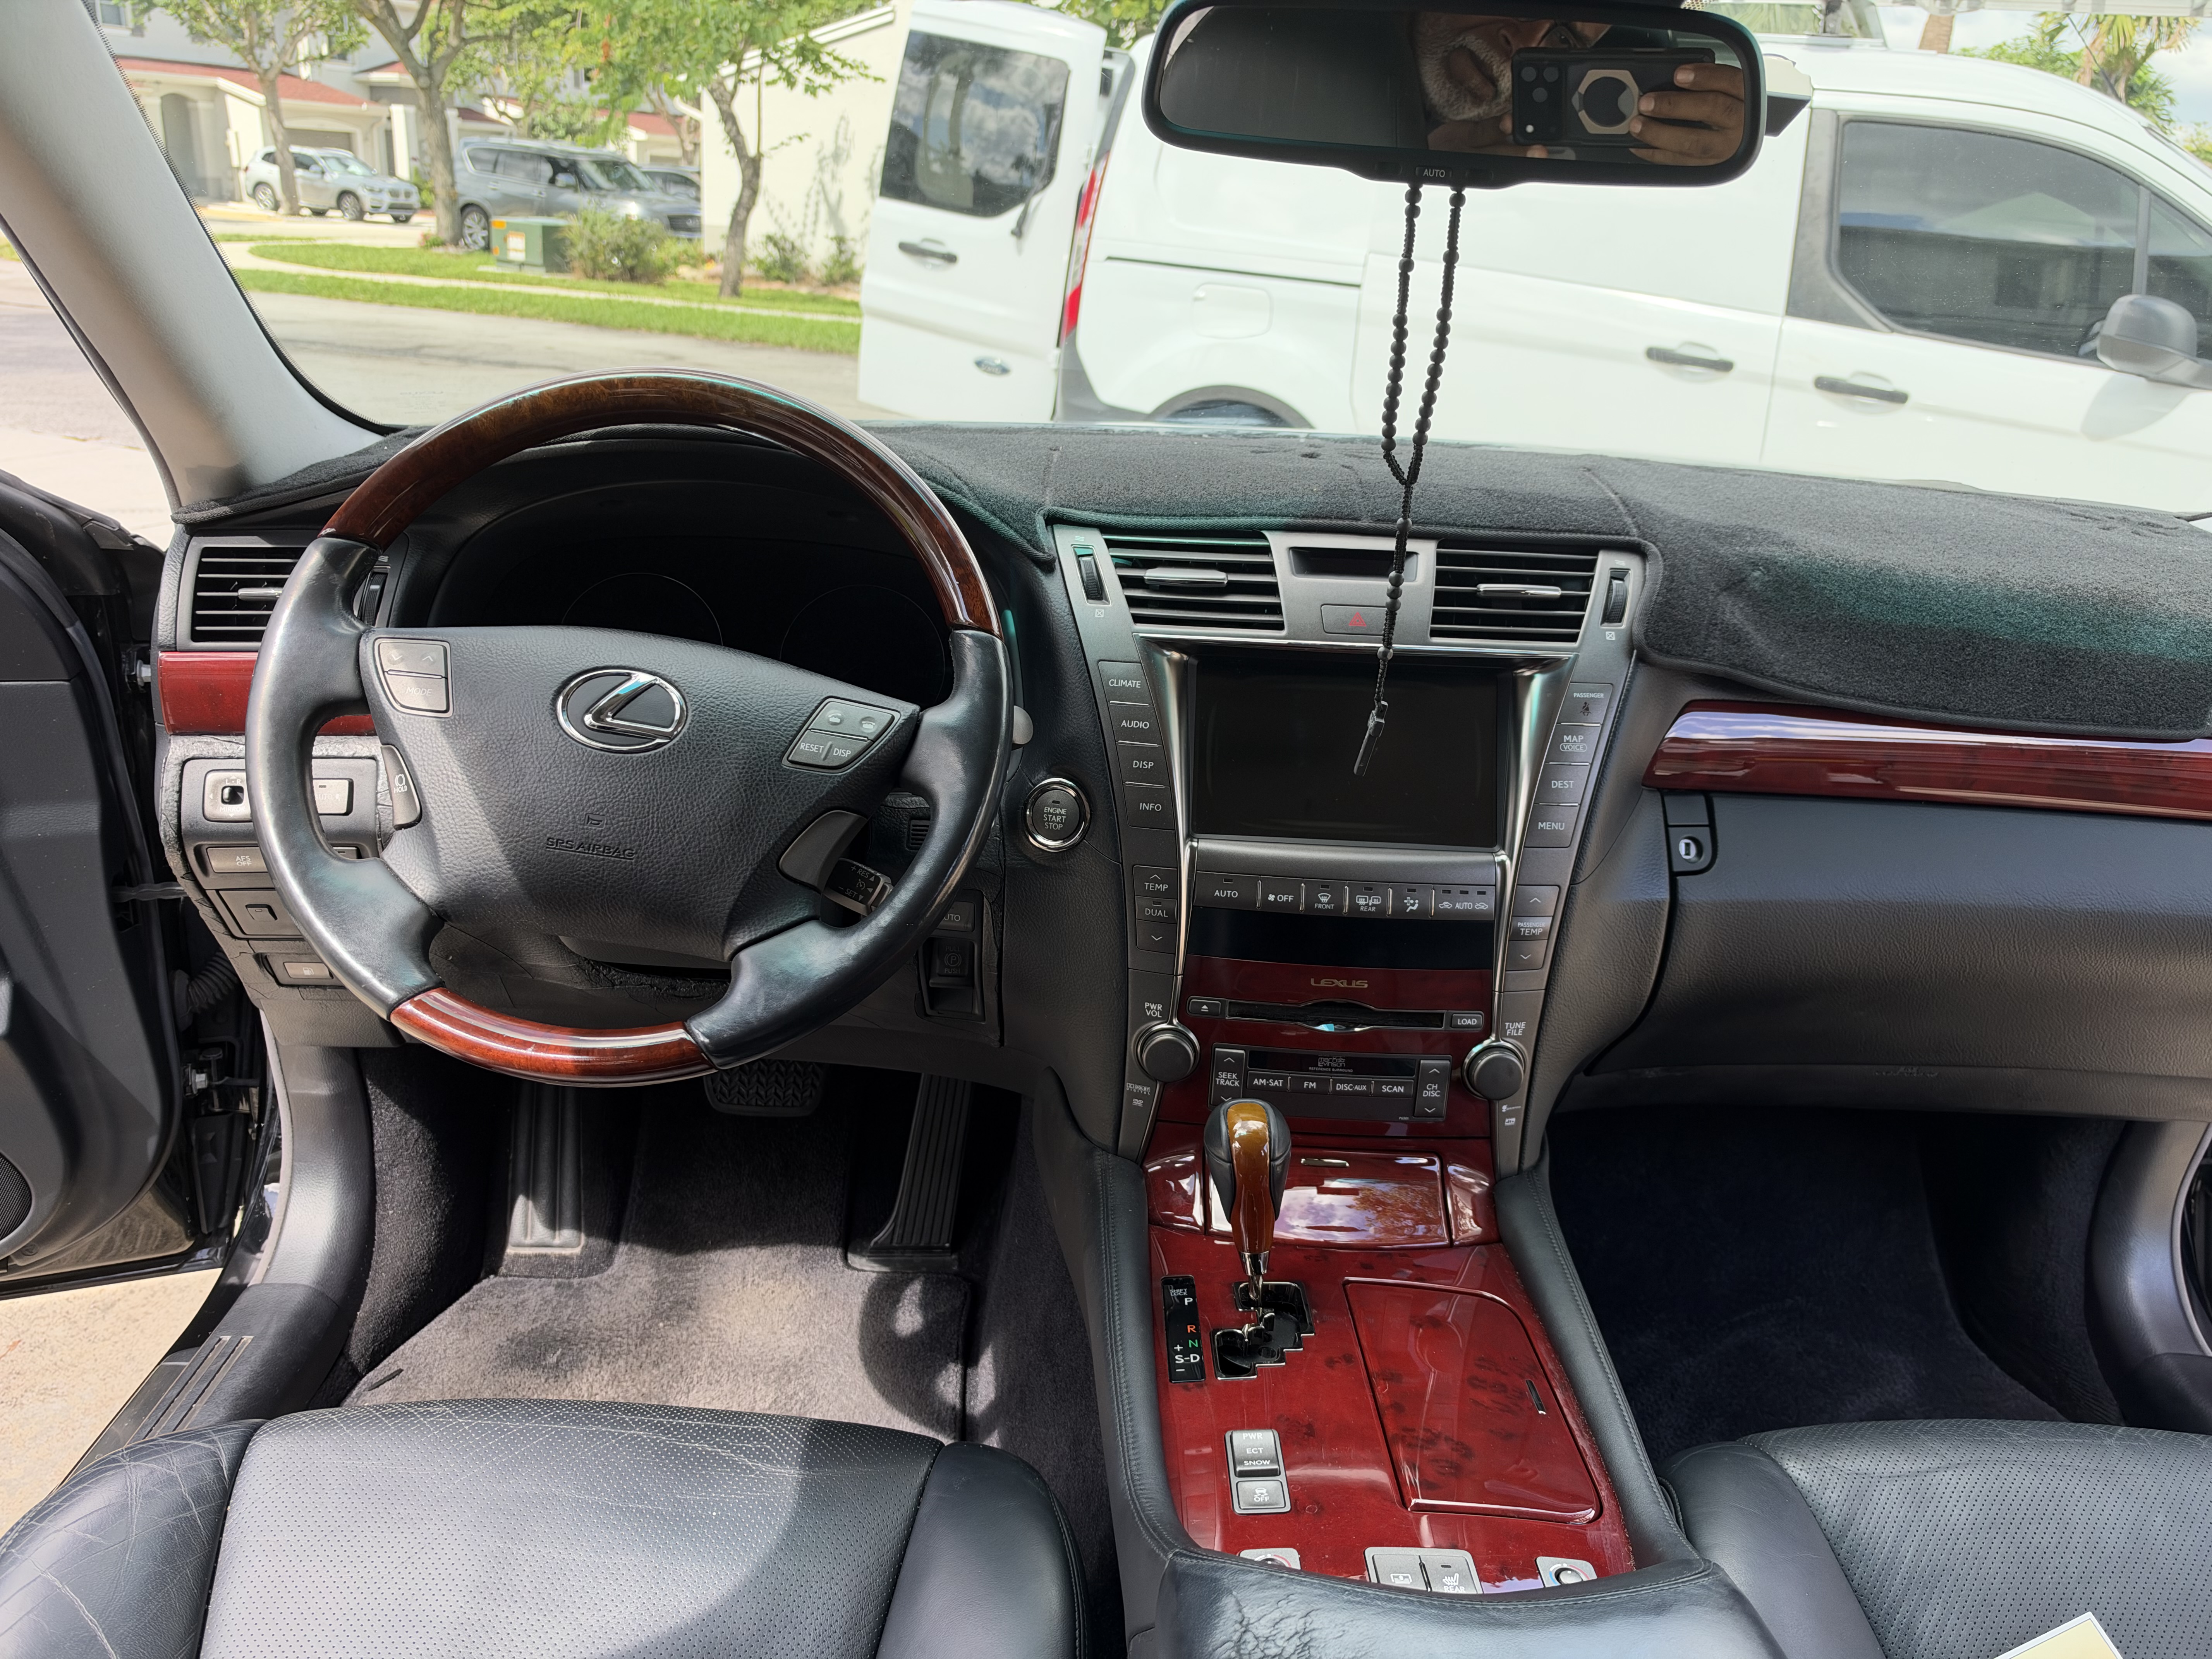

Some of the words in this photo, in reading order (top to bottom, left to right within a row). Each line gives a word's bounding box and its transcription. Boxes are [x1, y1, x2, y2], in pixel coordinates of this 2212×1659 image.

[1423, 169, 1445, 177] AUTO
[1109, 679, 1141, 688] CLIMATE
[406, 687, 432, 696] MODE
[1121, 720, 1149, 729] AUDIO
[800, 742, 824, 753] RESET
[833, 748, 851, 757] DISP
[1133, 761, 1154, 769] DISP
[394, 785, 407, 793] HOLD
[1044, 807, 1067, 815] ENGINE
[1139, 803, 1162, 812] INFO
[1043, 814, 1066, 823] START
[1045, 822, 1063, 830] STOP
[1538, 822, 1565, 830] MENU
[546, 838, 575, 850] SRS
[575, 842, 635, 859] AIRBAG
[857, 868, 870, 878] RES
[1144, 883, 1168, 891] TEMP
[845, 888, 858, 898] SET
[1145, 908, 1168, 917] DUAL
[1310, 978, 1368, 988] LEXUS
[1145, 1002, 1162, 1011] PWR
[1146, 1009, 1162, 1018] VOL
[1216, 1079, 1240, 1087] TRACK
[1127, 1087, 1150, 1095] DIGITAL
[1185, 1297, 1193, 1305] P
[1187, 1325, 1197, 1333] R
[1188, 1339, 1198, 1348] N
